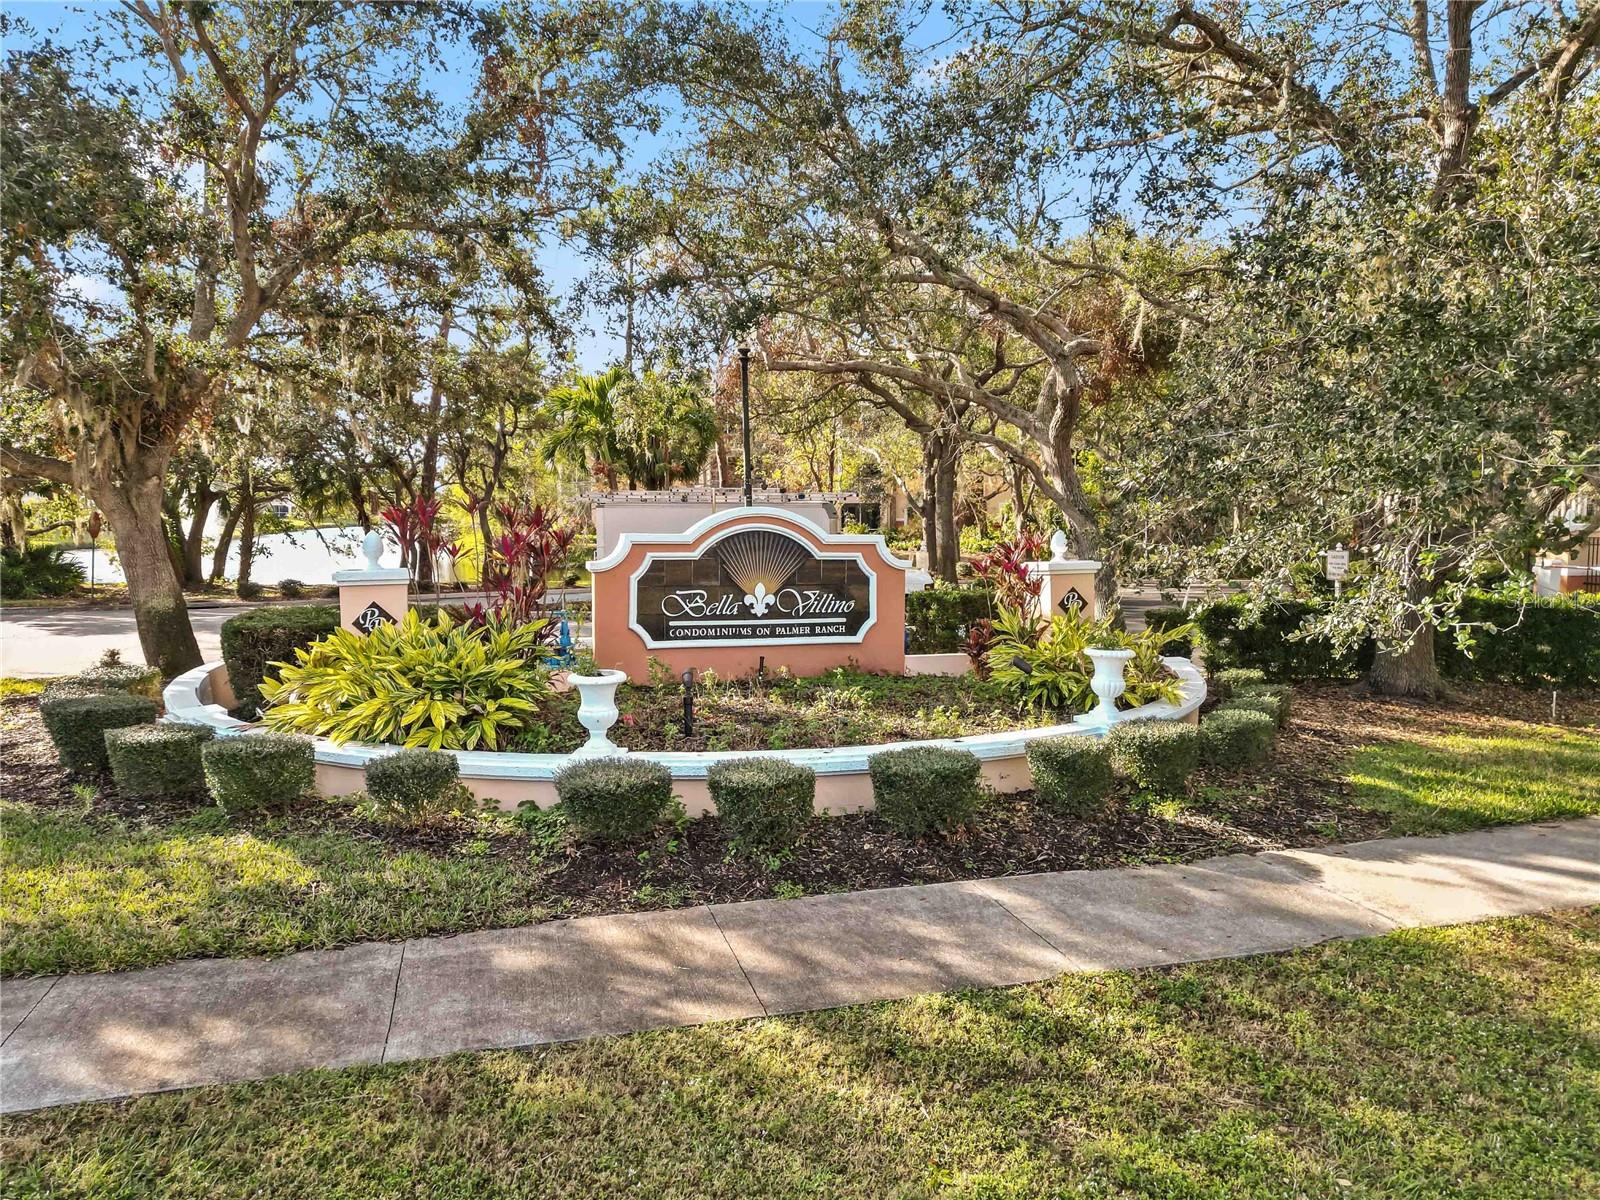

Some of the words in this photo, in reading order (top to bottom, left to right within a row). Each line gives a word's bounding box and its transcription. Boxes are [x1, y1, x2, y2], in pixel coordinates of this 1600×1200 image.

[661, 589, 743, 617] Bella
[776, 588, 856, 616] Villino
[669, 626, 752, 637] CONDOMINIUMS
[756, 626, 771, 636] ON
[776, 625, 811, 635] PALMER
[815, 624, 846, 634] RANCH
